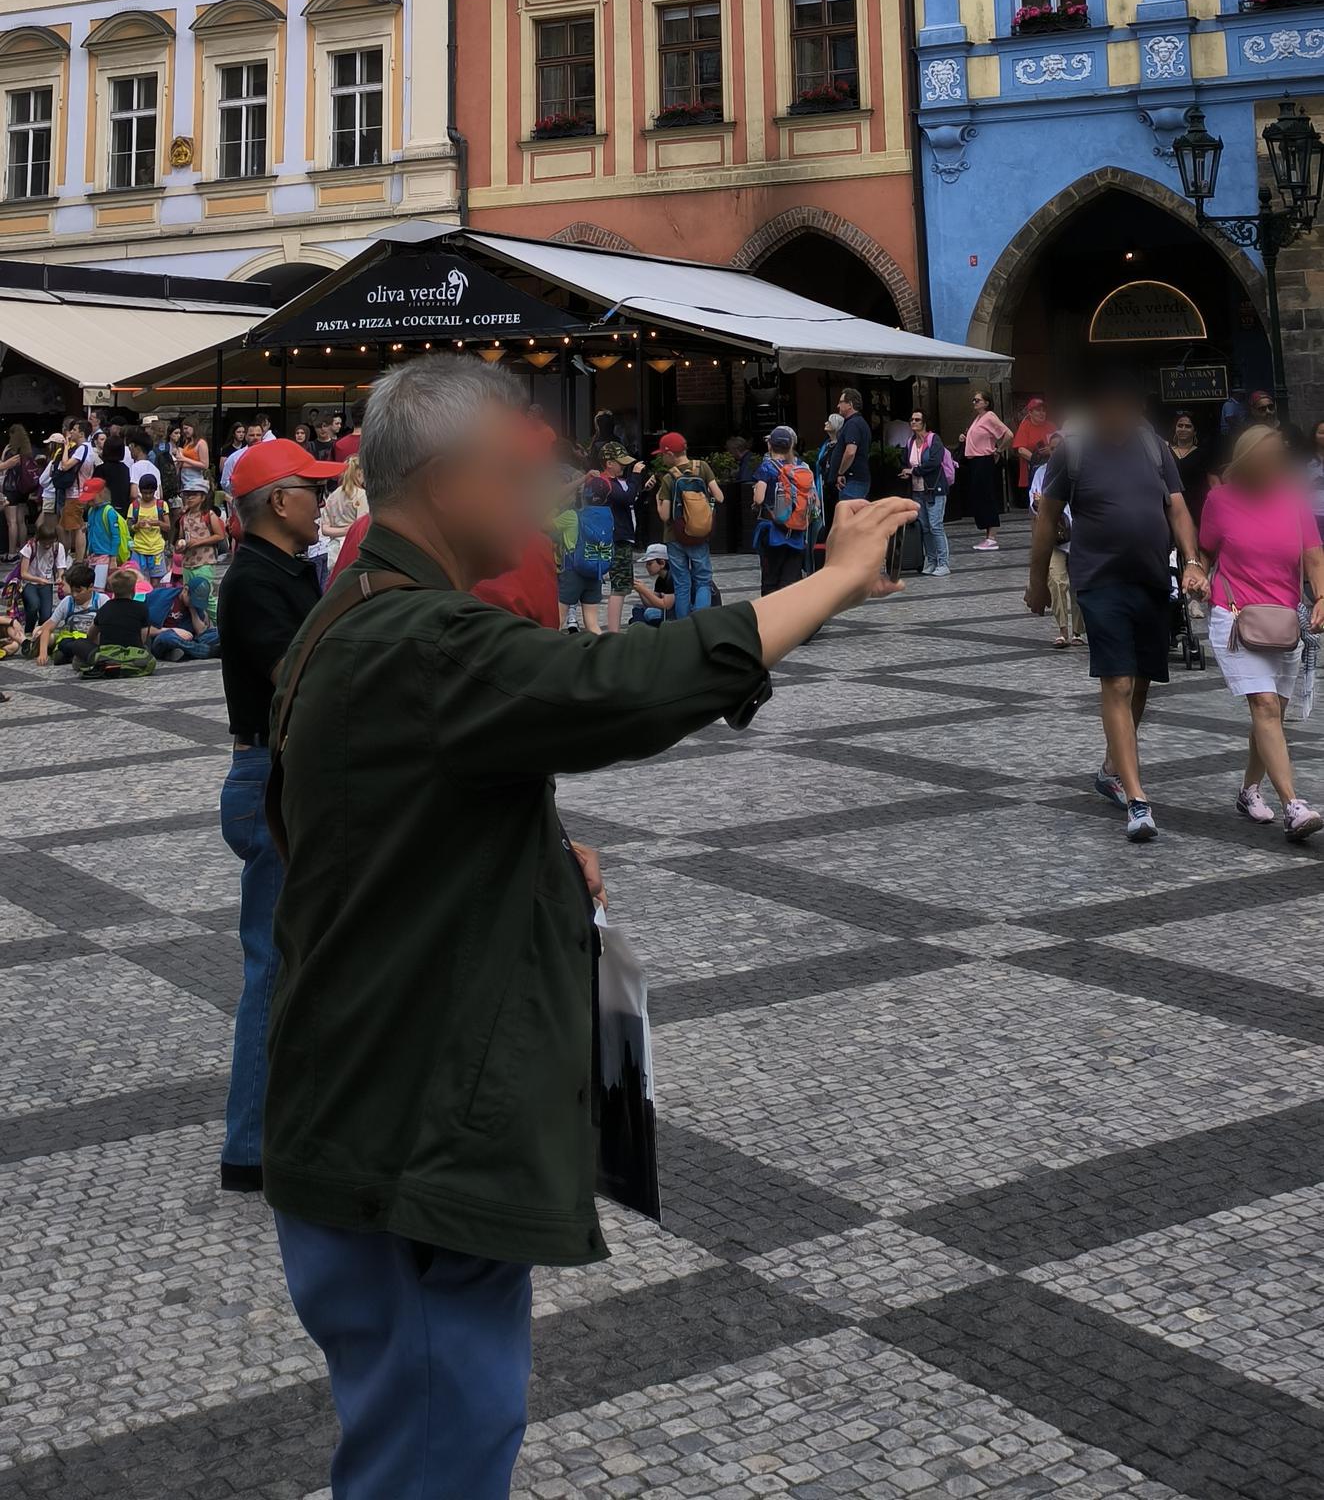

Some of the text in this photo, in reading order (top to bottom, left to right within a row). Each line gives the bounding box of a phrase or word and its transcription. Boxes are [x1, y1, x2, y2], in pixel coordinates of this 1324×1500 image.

[367, 282, 456, 303] oliva verde
[315, 313, 521, 331] PASTA PIZZA COCKTAIL COFFEE
[1170, 370, 1216, 379] RESTAURANT
